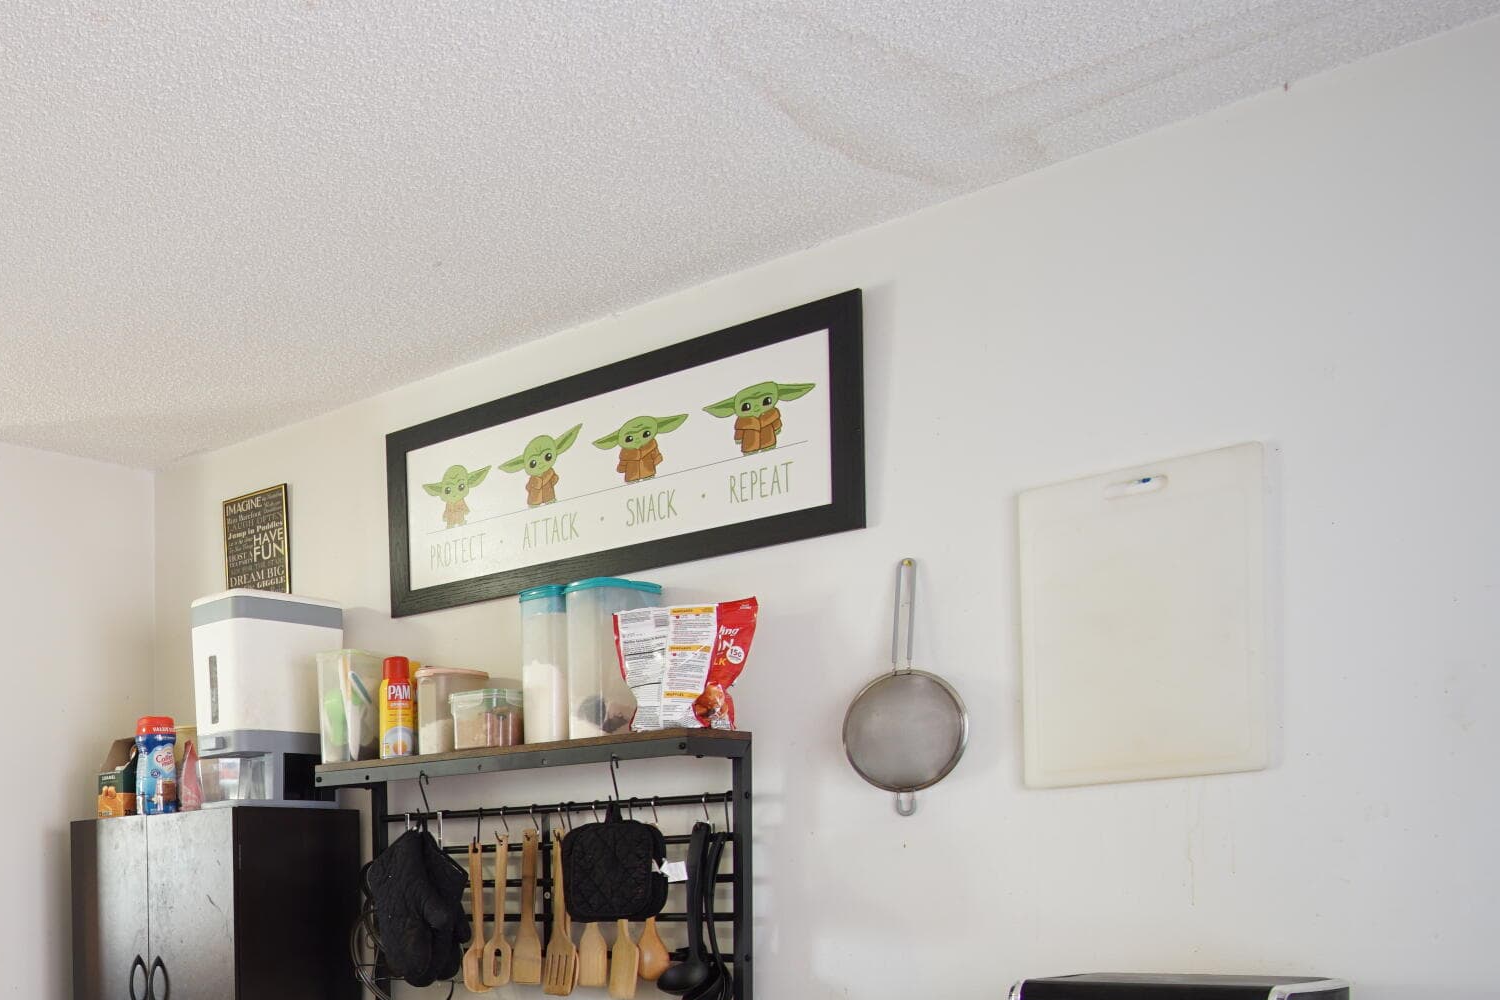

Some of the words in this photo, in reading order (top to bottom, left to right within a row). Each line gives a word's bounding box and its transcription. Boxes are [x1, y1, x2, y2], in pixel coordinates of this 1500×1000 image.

[226, 496, 262, 516] IMAGINE
[429, 532, 487, 570] PROTECT
[522, 512, 580, 551] ATTACK
[626, 488, 678, 527] SNACK
[729, 461, 794, 504] REPEAT
[228, 531, 247, 541] Jump
[253, 527, 284, 547] HAVE
[253, 540, 285, 563] FUN
[230, 569, 265, 588] DREAM
[267, 565, 285, 579] BIG
[387, 684, 411, 701] PAM
